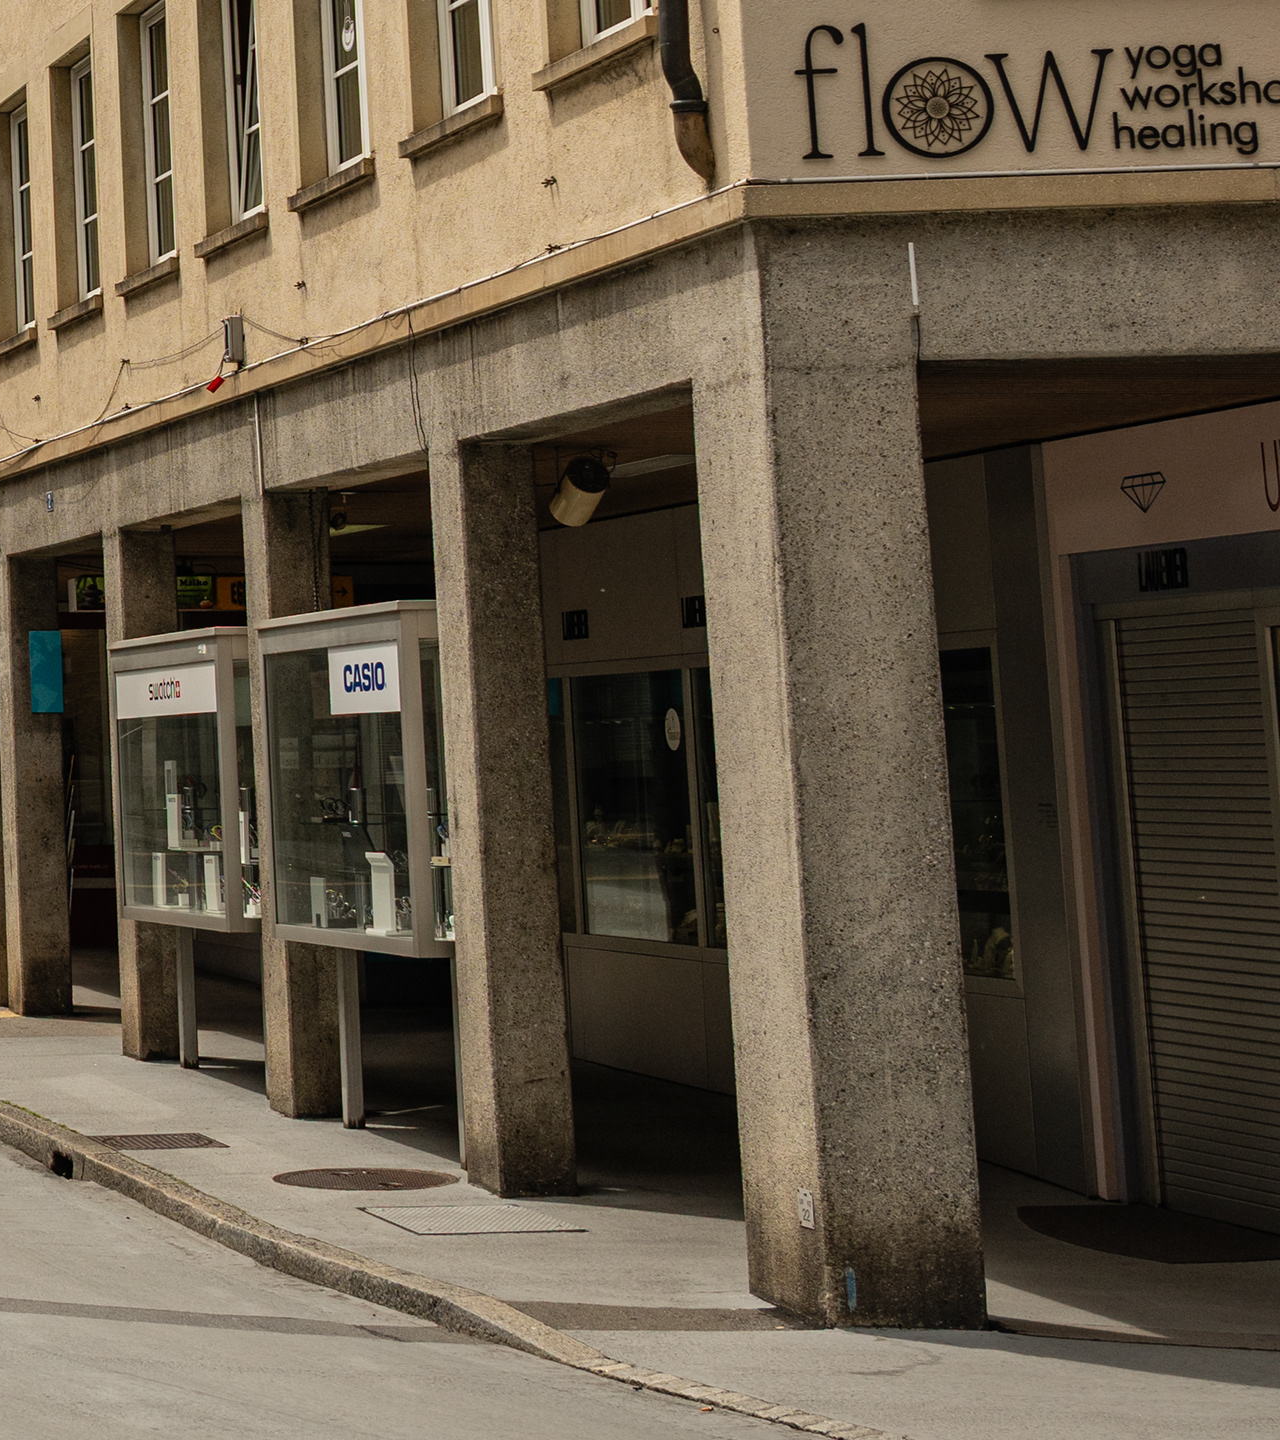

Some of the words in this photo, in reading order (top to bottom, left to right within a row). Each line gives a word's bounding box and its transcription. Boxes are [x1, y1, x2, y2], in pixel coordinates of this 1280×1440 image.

[1124, 43, 1222, 79] yoga
[794, 22, 1114, 160] flow
[1112, 109, 1259, 155] healing
[148, 677, 176, 701] swatch
[343, 661, 385, 693] CASIO
